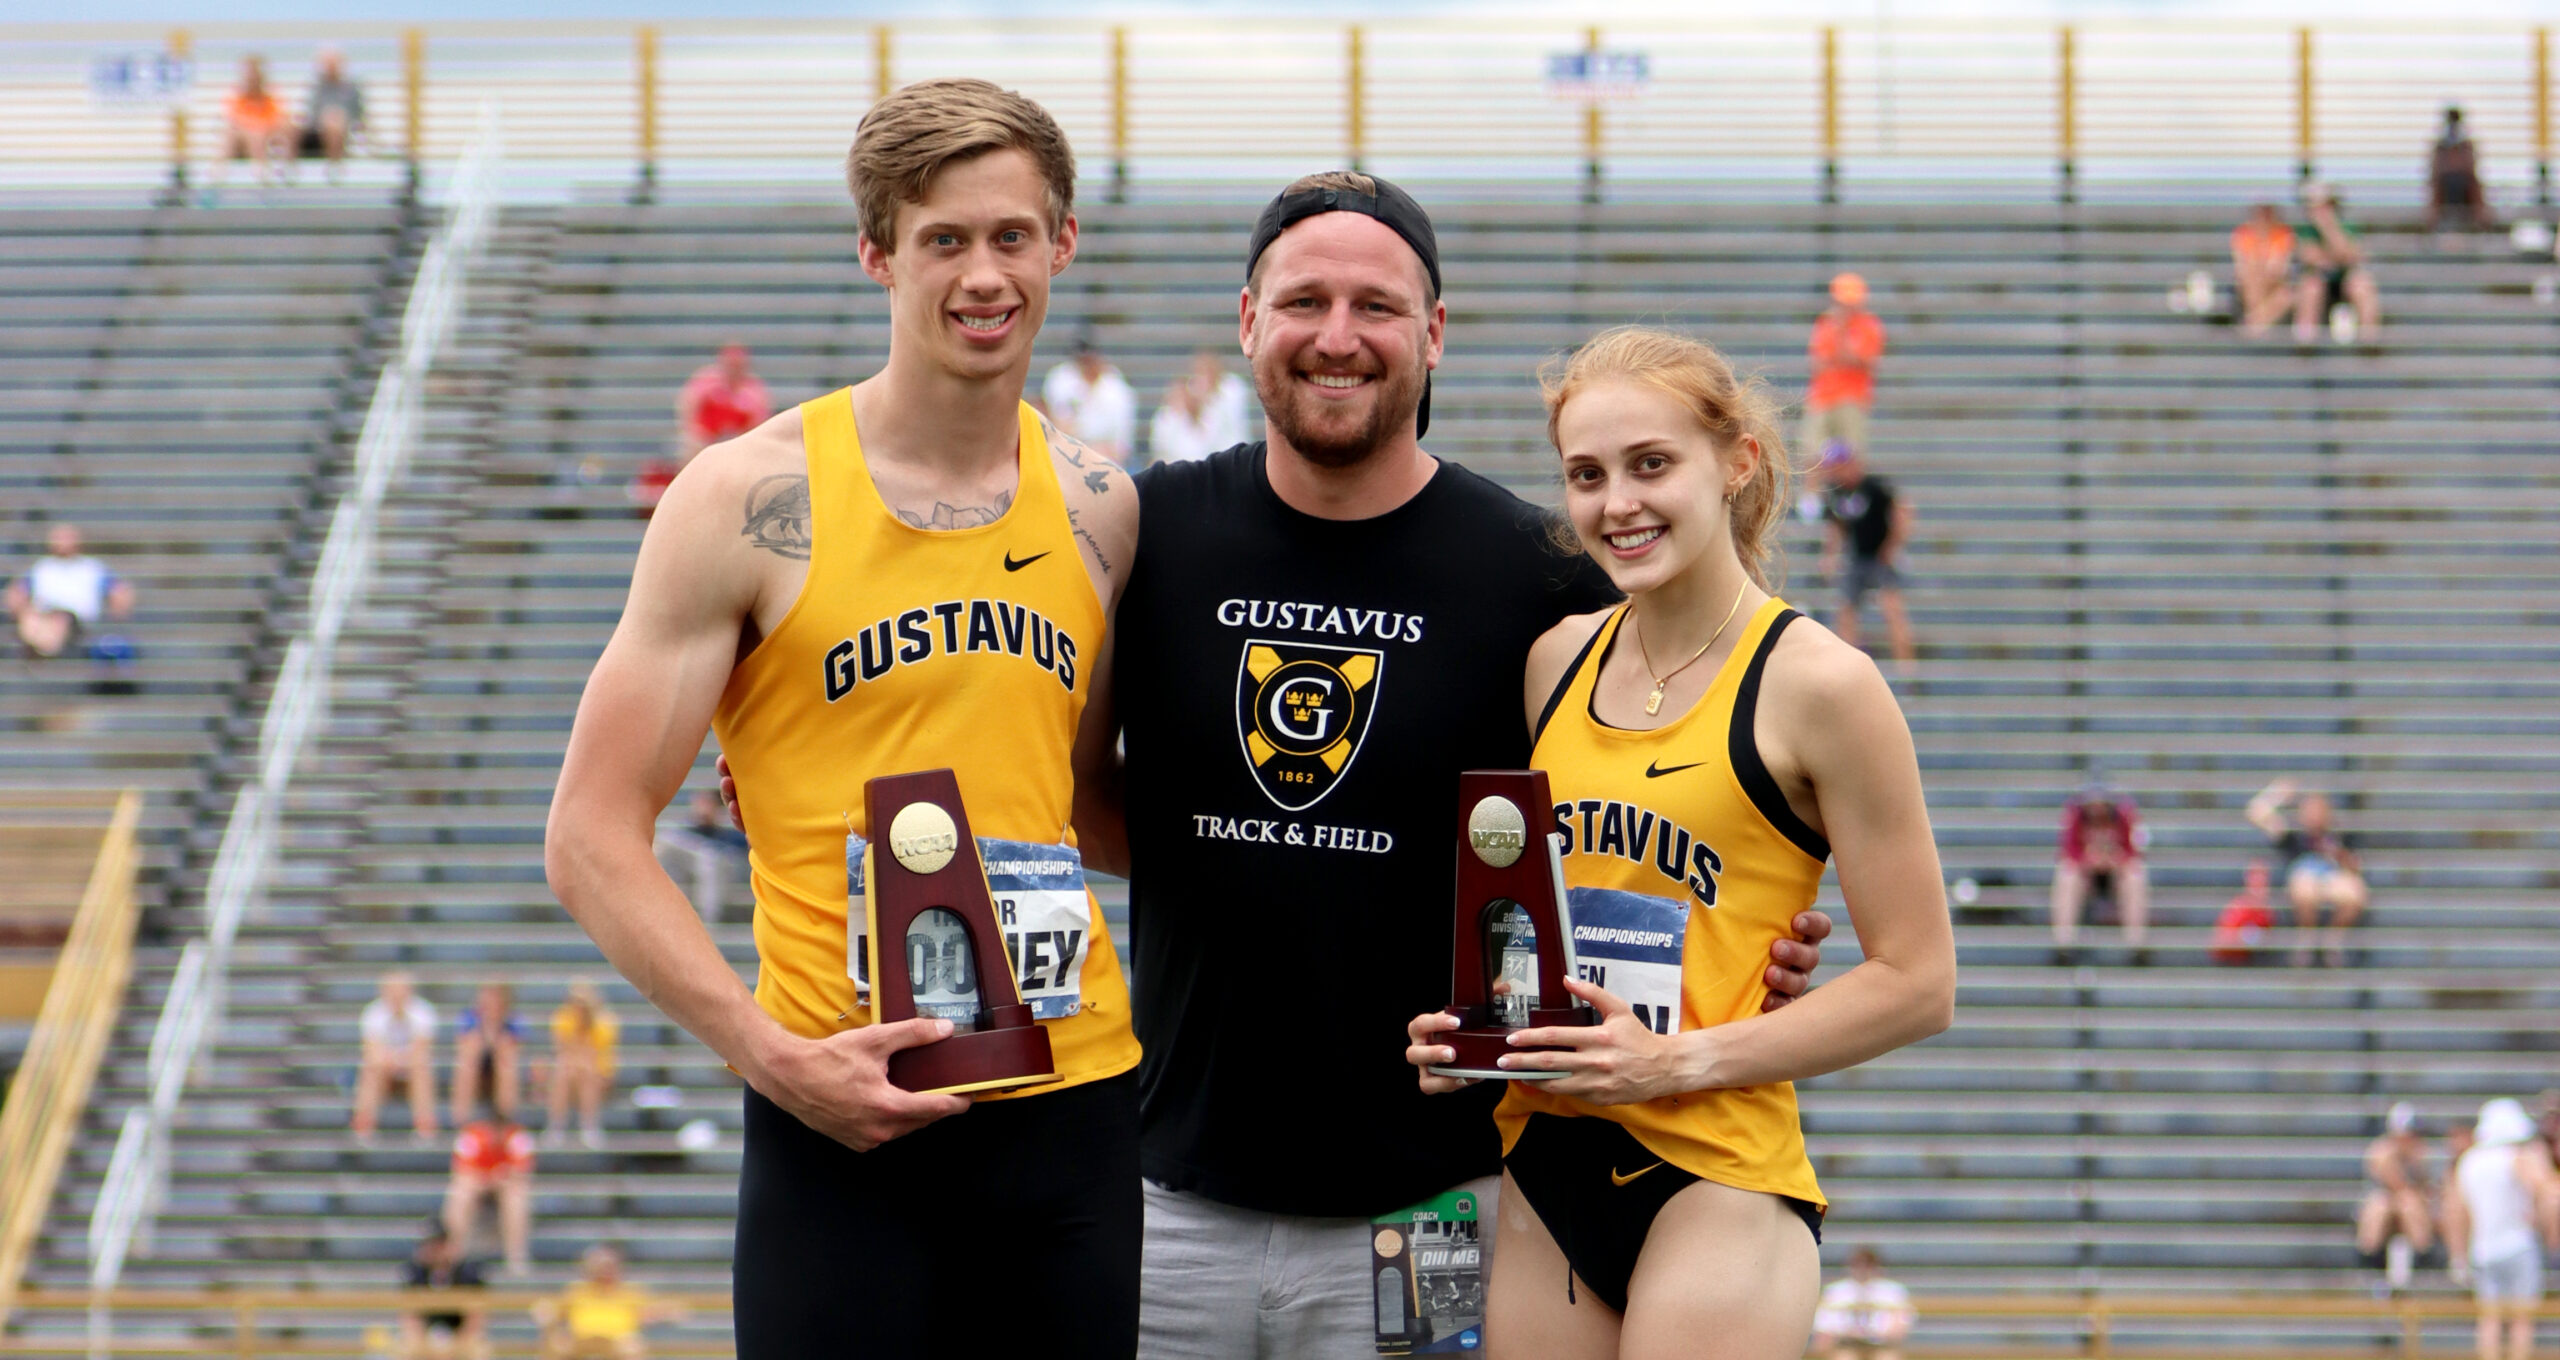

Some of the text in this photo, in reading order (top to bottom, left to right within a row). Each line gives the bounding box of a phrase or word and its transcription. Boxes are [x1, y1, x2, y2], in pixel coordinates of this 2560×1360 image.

[1217, 599, 1423, 643] GUSTAVUS
[824, 599, 1076, 703] GUSTAVUS
[1270, 677, 1334, 740] G
[1278, 770, 1314, 784] 1862
[898, 832, 956, 859] NCAA
[1193, 815, 1393, 853] TRACK & FIELD
[1473, 829, 1523, 849] NCAA
[1553, 799, 1723, 908] STAVUS
[1574, 926, 1674, 948] CHAMPIONSHIPS
[1412, 1211, 1439, 1222] COACH
